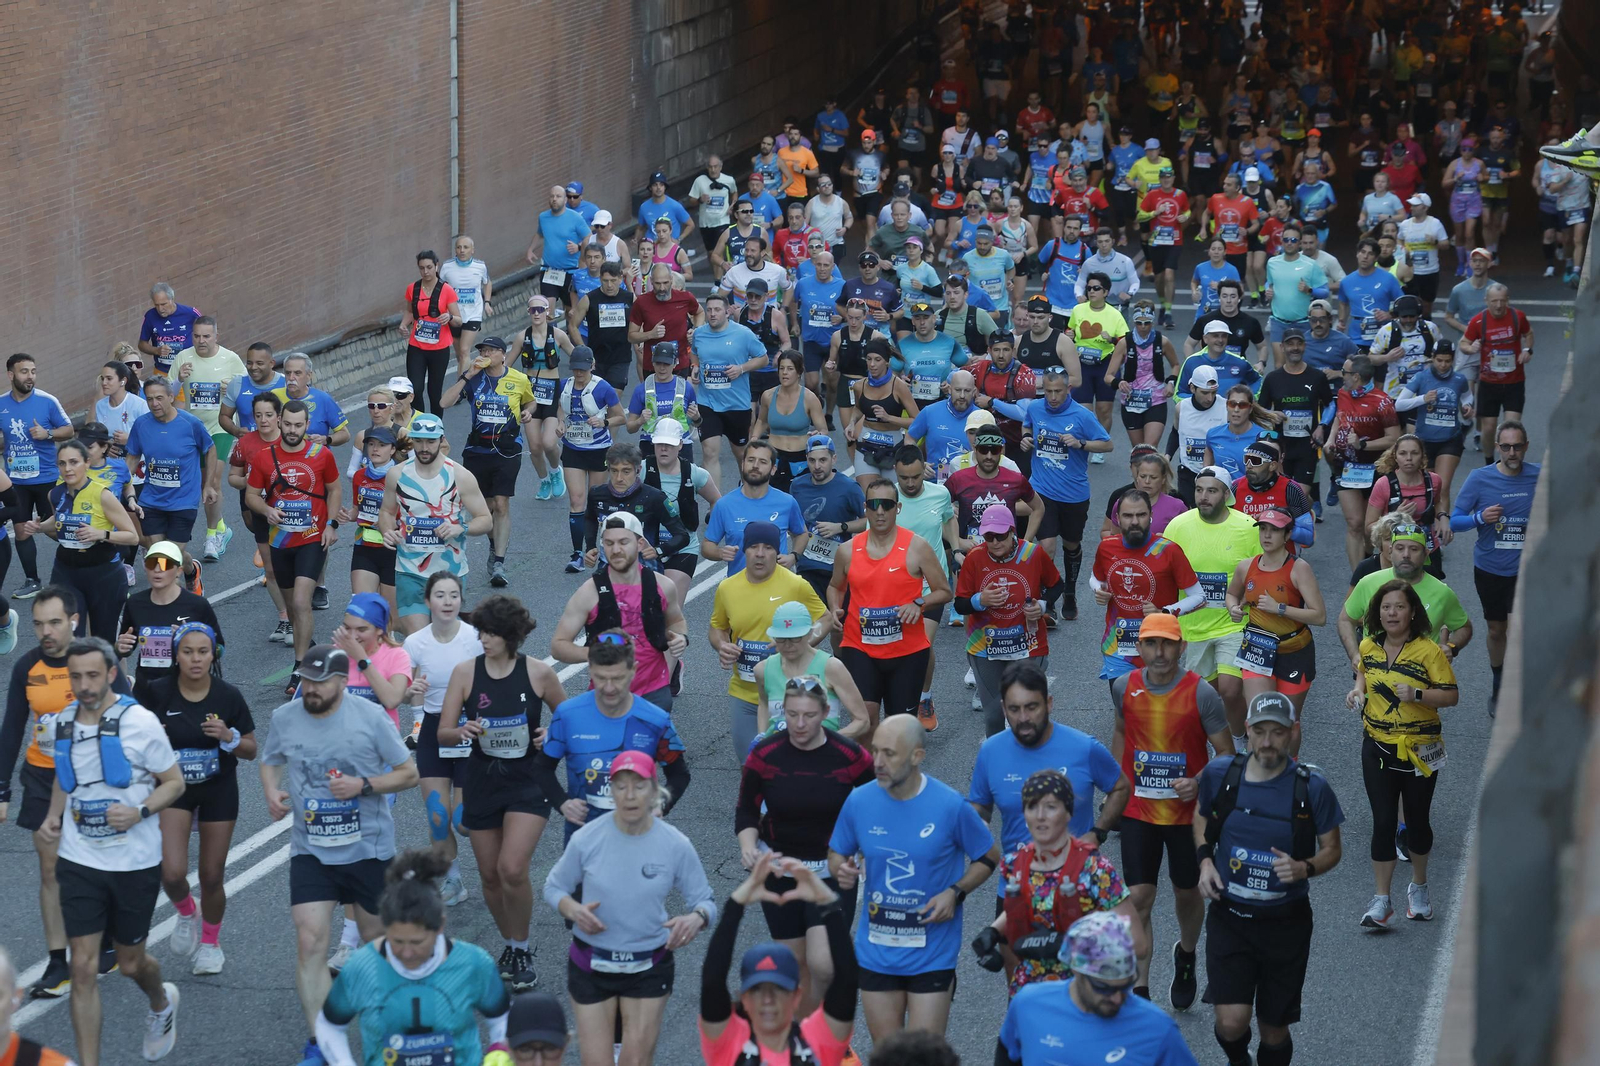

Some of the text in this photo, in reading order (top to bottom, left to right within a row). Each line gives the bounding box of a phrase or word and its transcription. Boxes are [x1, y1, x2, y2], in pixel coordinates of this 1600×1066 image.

[195, 396, 216, 404] TABOAS
[871, 432, 895, 443] ZURICH
[149, 472, 172, 480] CARLOS
[282, 517, 303, 526] ISAAC
[411, 536, 439, 544] KIERAN
[1502, 533, 1525, 541] FERRO
[810, 542, 832, 557] LÓPEZ
[861, 624, 901, 636] JUAN DÍEZ
[1252, 635, 1274, 646] ZURICH
[141, 648, 160, 657] VALE
[987, 641, 1027, 654] CONSUELO
[1256, 698, 1282, 713] Gibson
[492, 717, 522, 726] ZURICH
[490, 739, 520, 748] EMMA
[183, 750, 213, 758] ZURICH
[1151, 754, 1180, 762] ZURICH
[1139, 776, 1175, 787] VICENT
[321, 800, 354, 809] ZURICH
[306, 821, 359, 836] WOJCIECH
[1248, 867, 1270, 878] 13209
[1246, 877, 1269, 890] SEB
[885, 895, 919, 905] ZURICH
[611, 951, 634, 961] EVA
[405, 1035, 445, 1049] ZURICH
